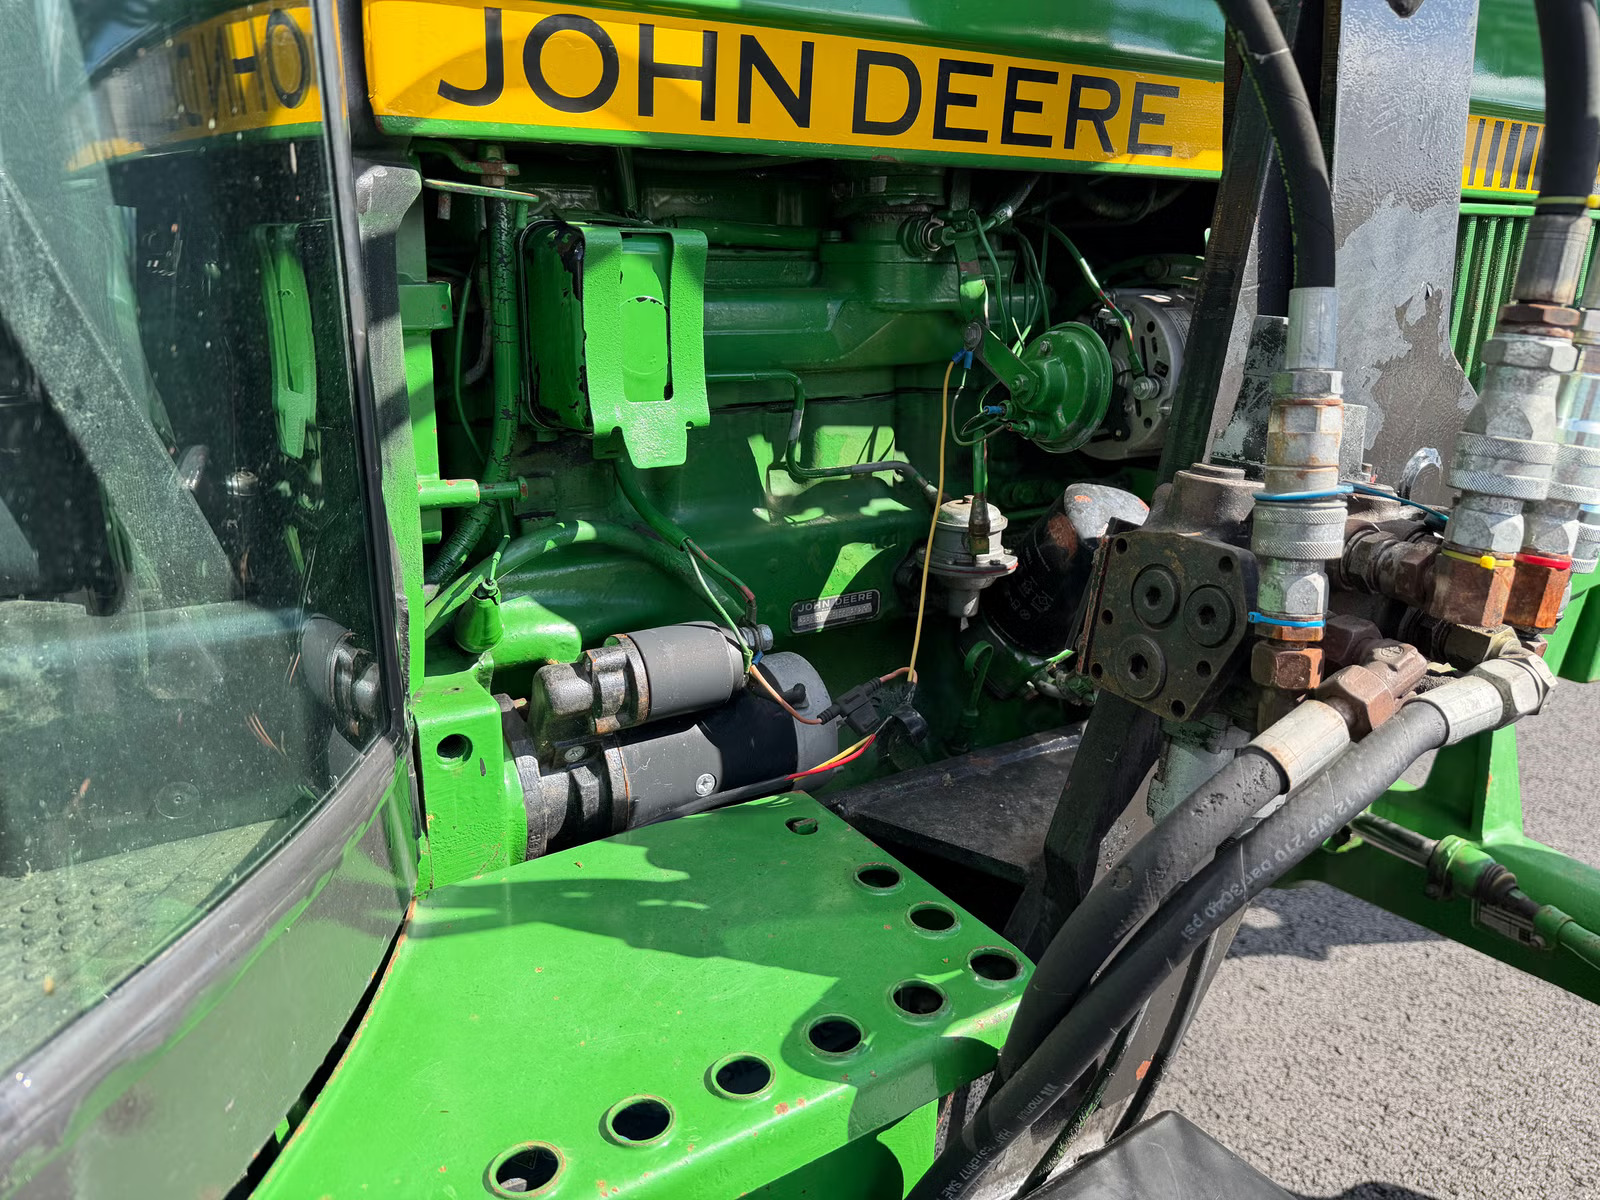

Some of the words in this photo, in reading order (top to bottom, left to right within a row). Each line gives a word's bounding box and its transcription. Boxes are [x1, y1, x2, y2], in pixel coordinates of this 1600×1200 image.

[437, 6, 815, 129] JOHN
[852, 48, 1181, 157] DEERE
[797, 599, 830, 613] JOHN
[836, 591, 873, 605] DEERE
[1334, 797, 1356, 815] 12
[1308, 811, 1336, 840] WP
[1276, 835, 1305, 864] 210
[1180, 912, 1205, 941] psi
